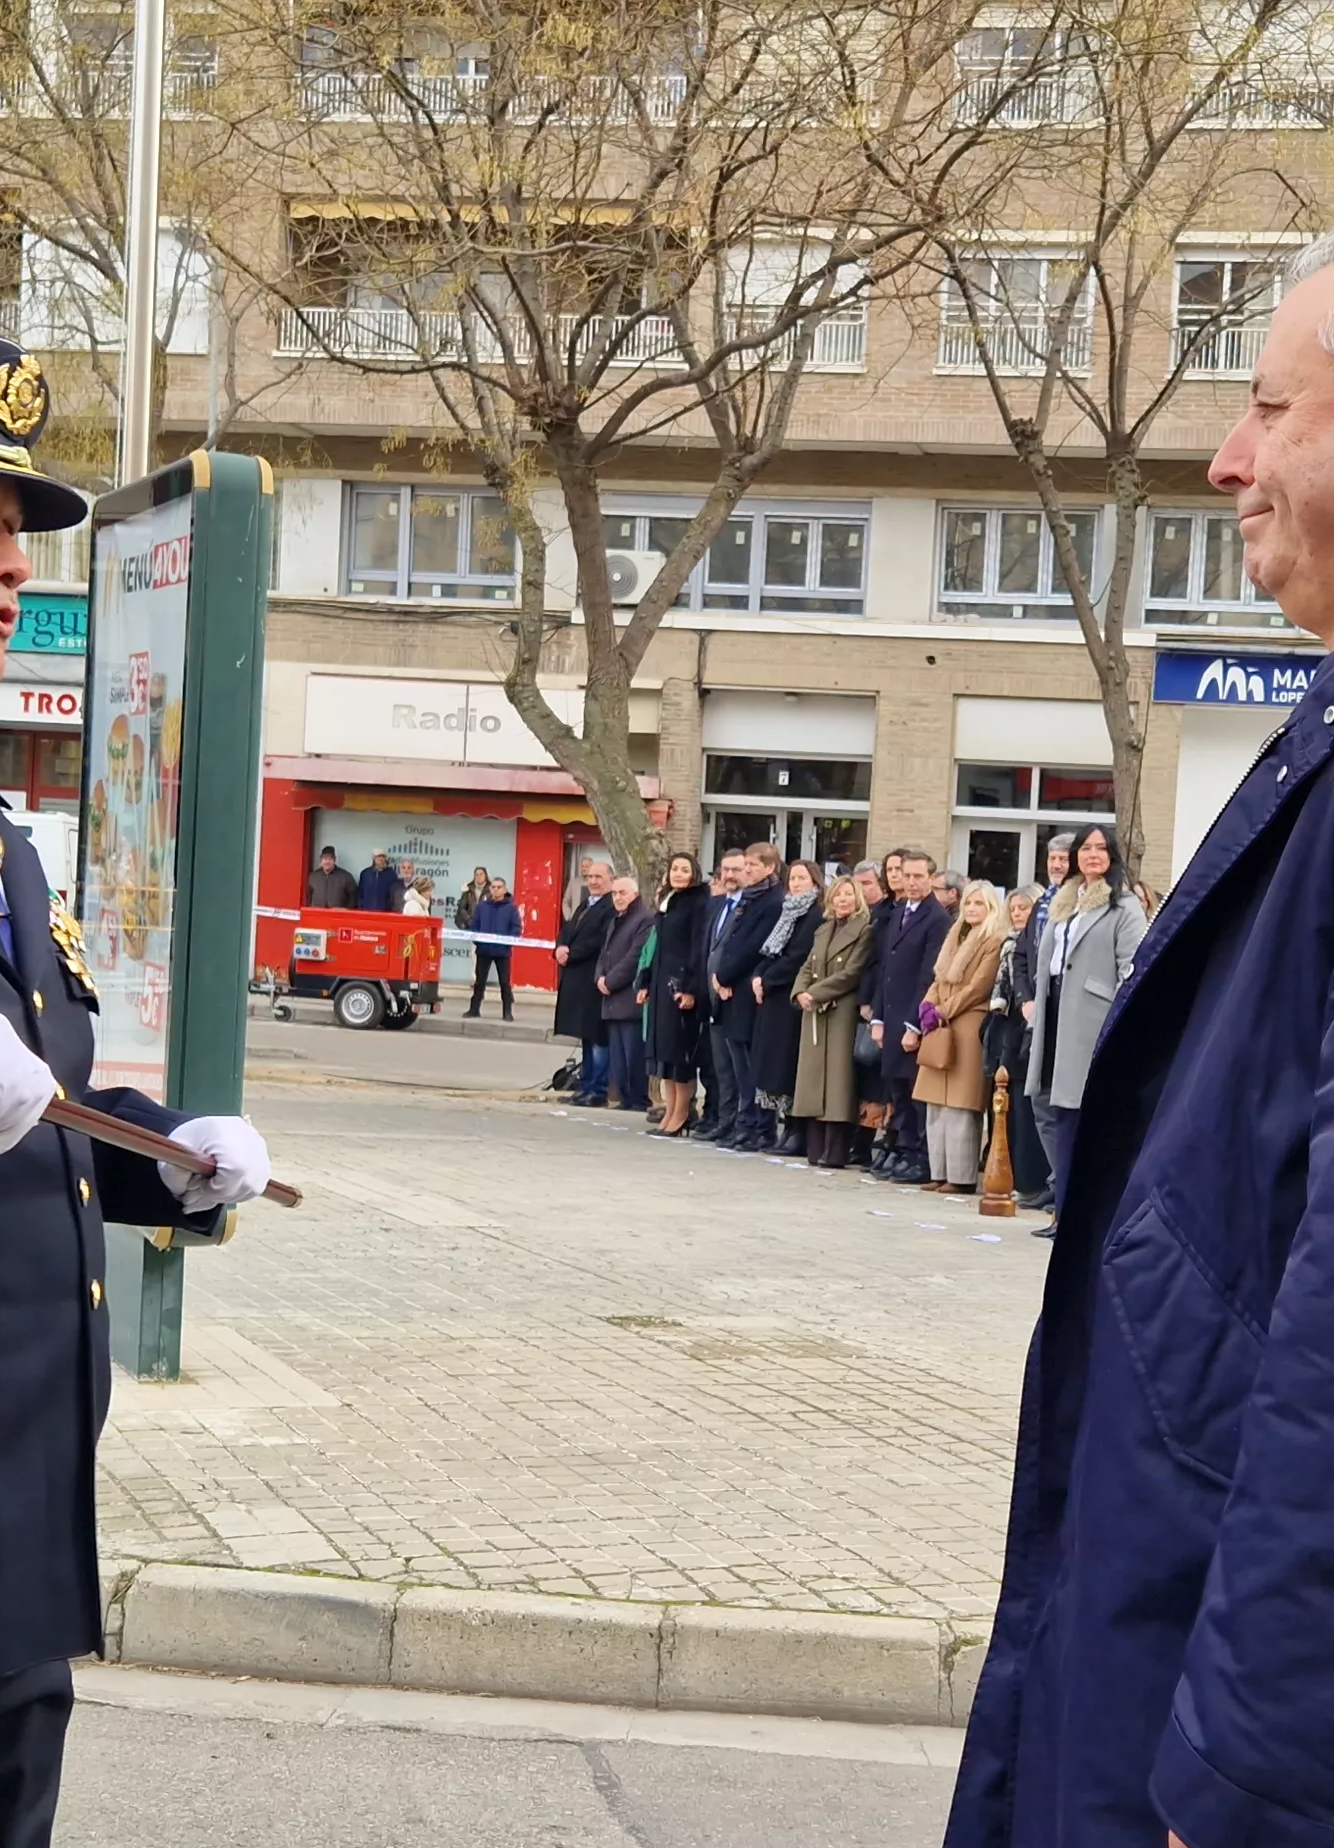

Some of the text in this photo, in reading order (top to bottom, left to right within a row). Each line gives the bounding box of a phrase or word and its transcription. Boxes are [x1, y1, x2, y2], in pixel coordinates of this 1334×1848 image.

[58, 637, 87, 649] EST
[20, 691, 82, 716] TRO
[392, 704, 502, 734] Radio
[405, 825, 435, 836] Grupo
[415, 866, 449, 878] ragón
